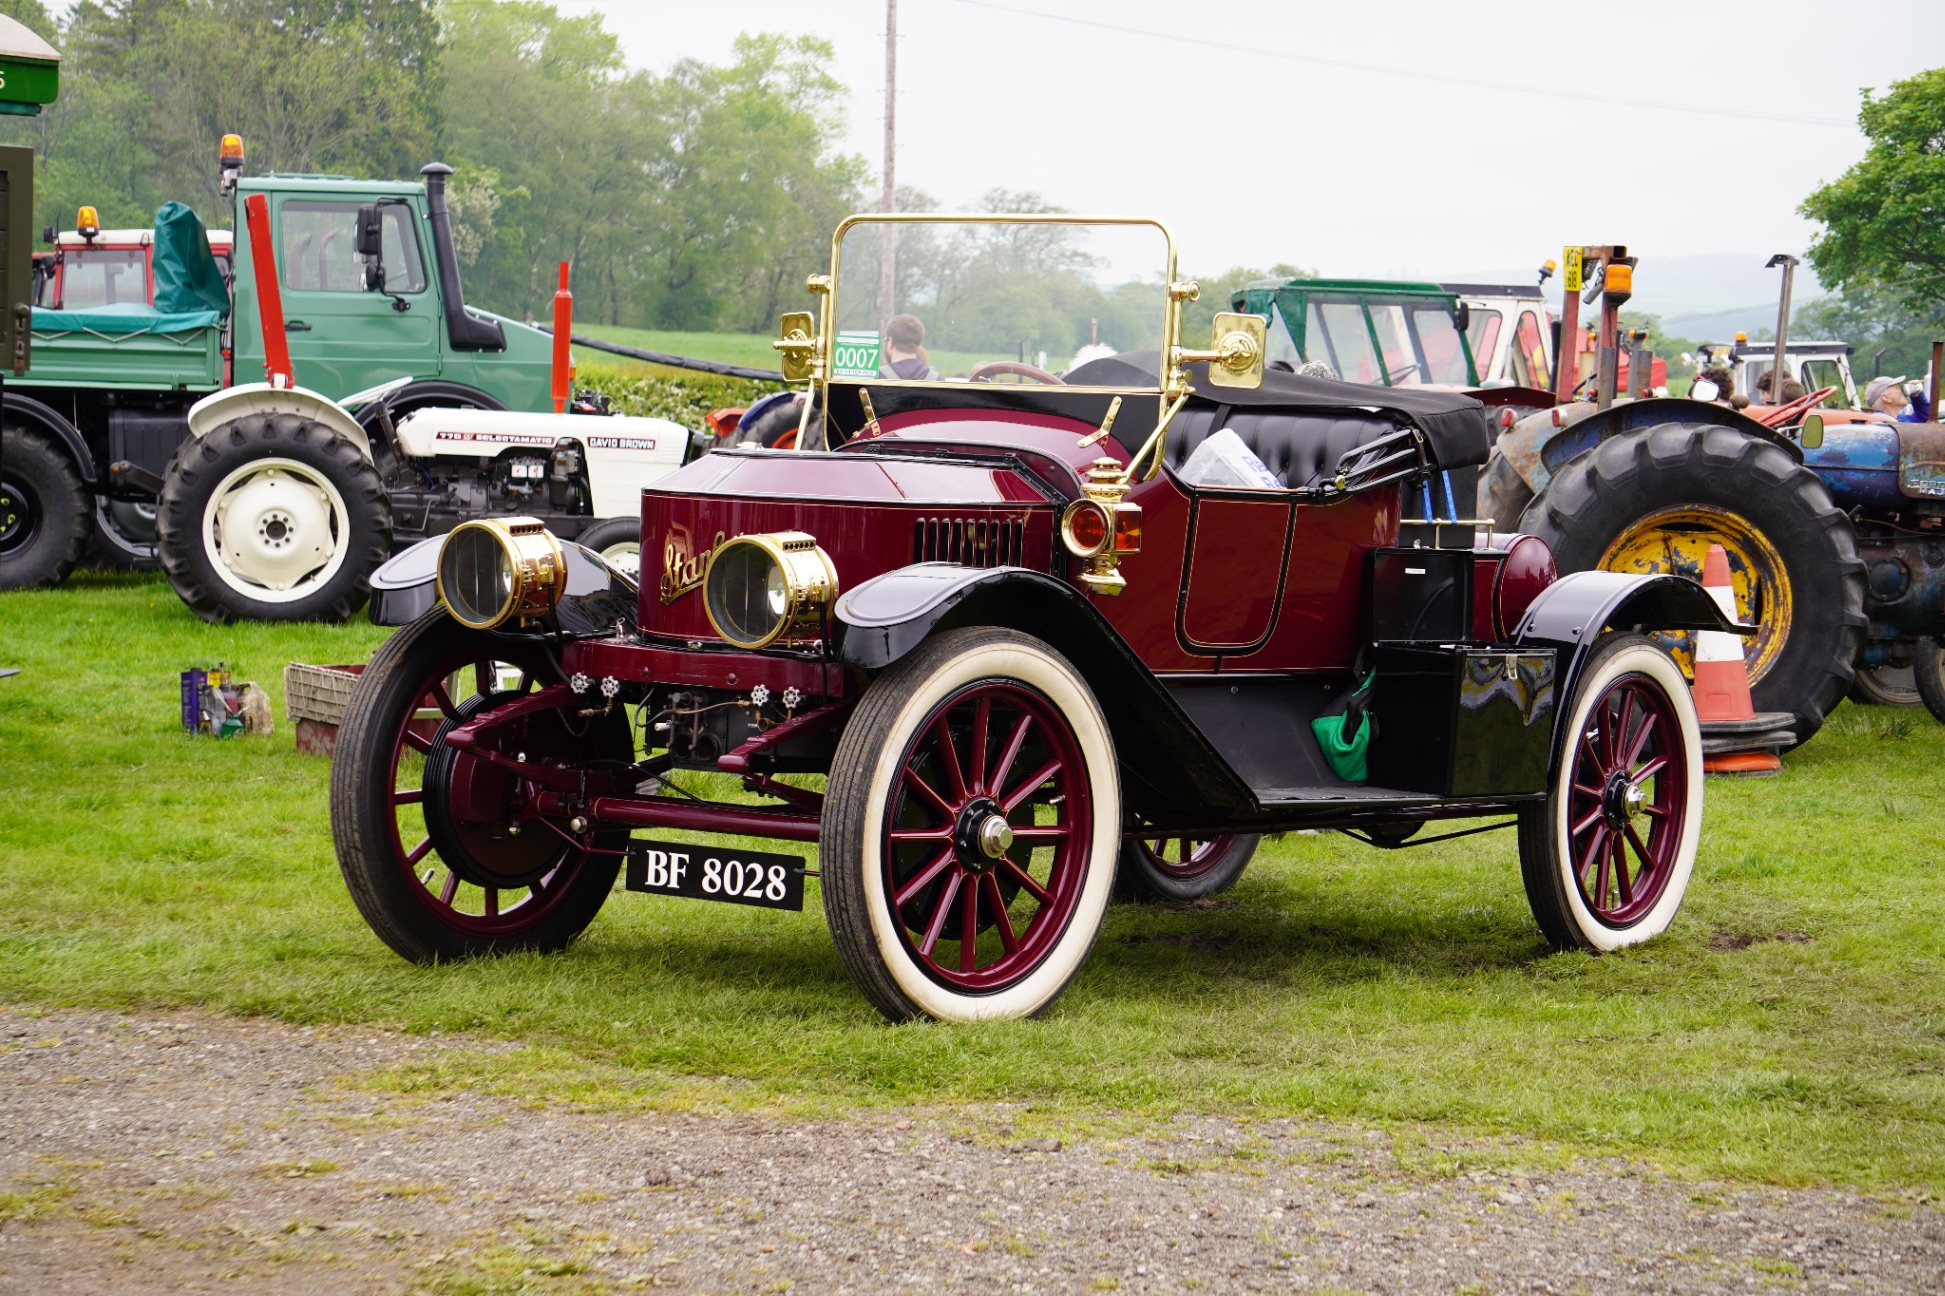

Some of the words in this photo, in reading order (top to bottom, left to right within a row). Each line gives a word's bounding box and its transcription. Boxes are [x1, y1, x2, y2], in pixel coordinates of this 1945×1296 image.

[836, 347, 878, 368] 0007
[440, 432, 462, 440] 770
[475, 434, 553, 444] SELECTAMATIC
[589, 437, 619, 448] DAVID
[620, 439, 655, 449] BROWN
[644, 850, 690, 888] BF
[701, 858, 786, 901] 8028
